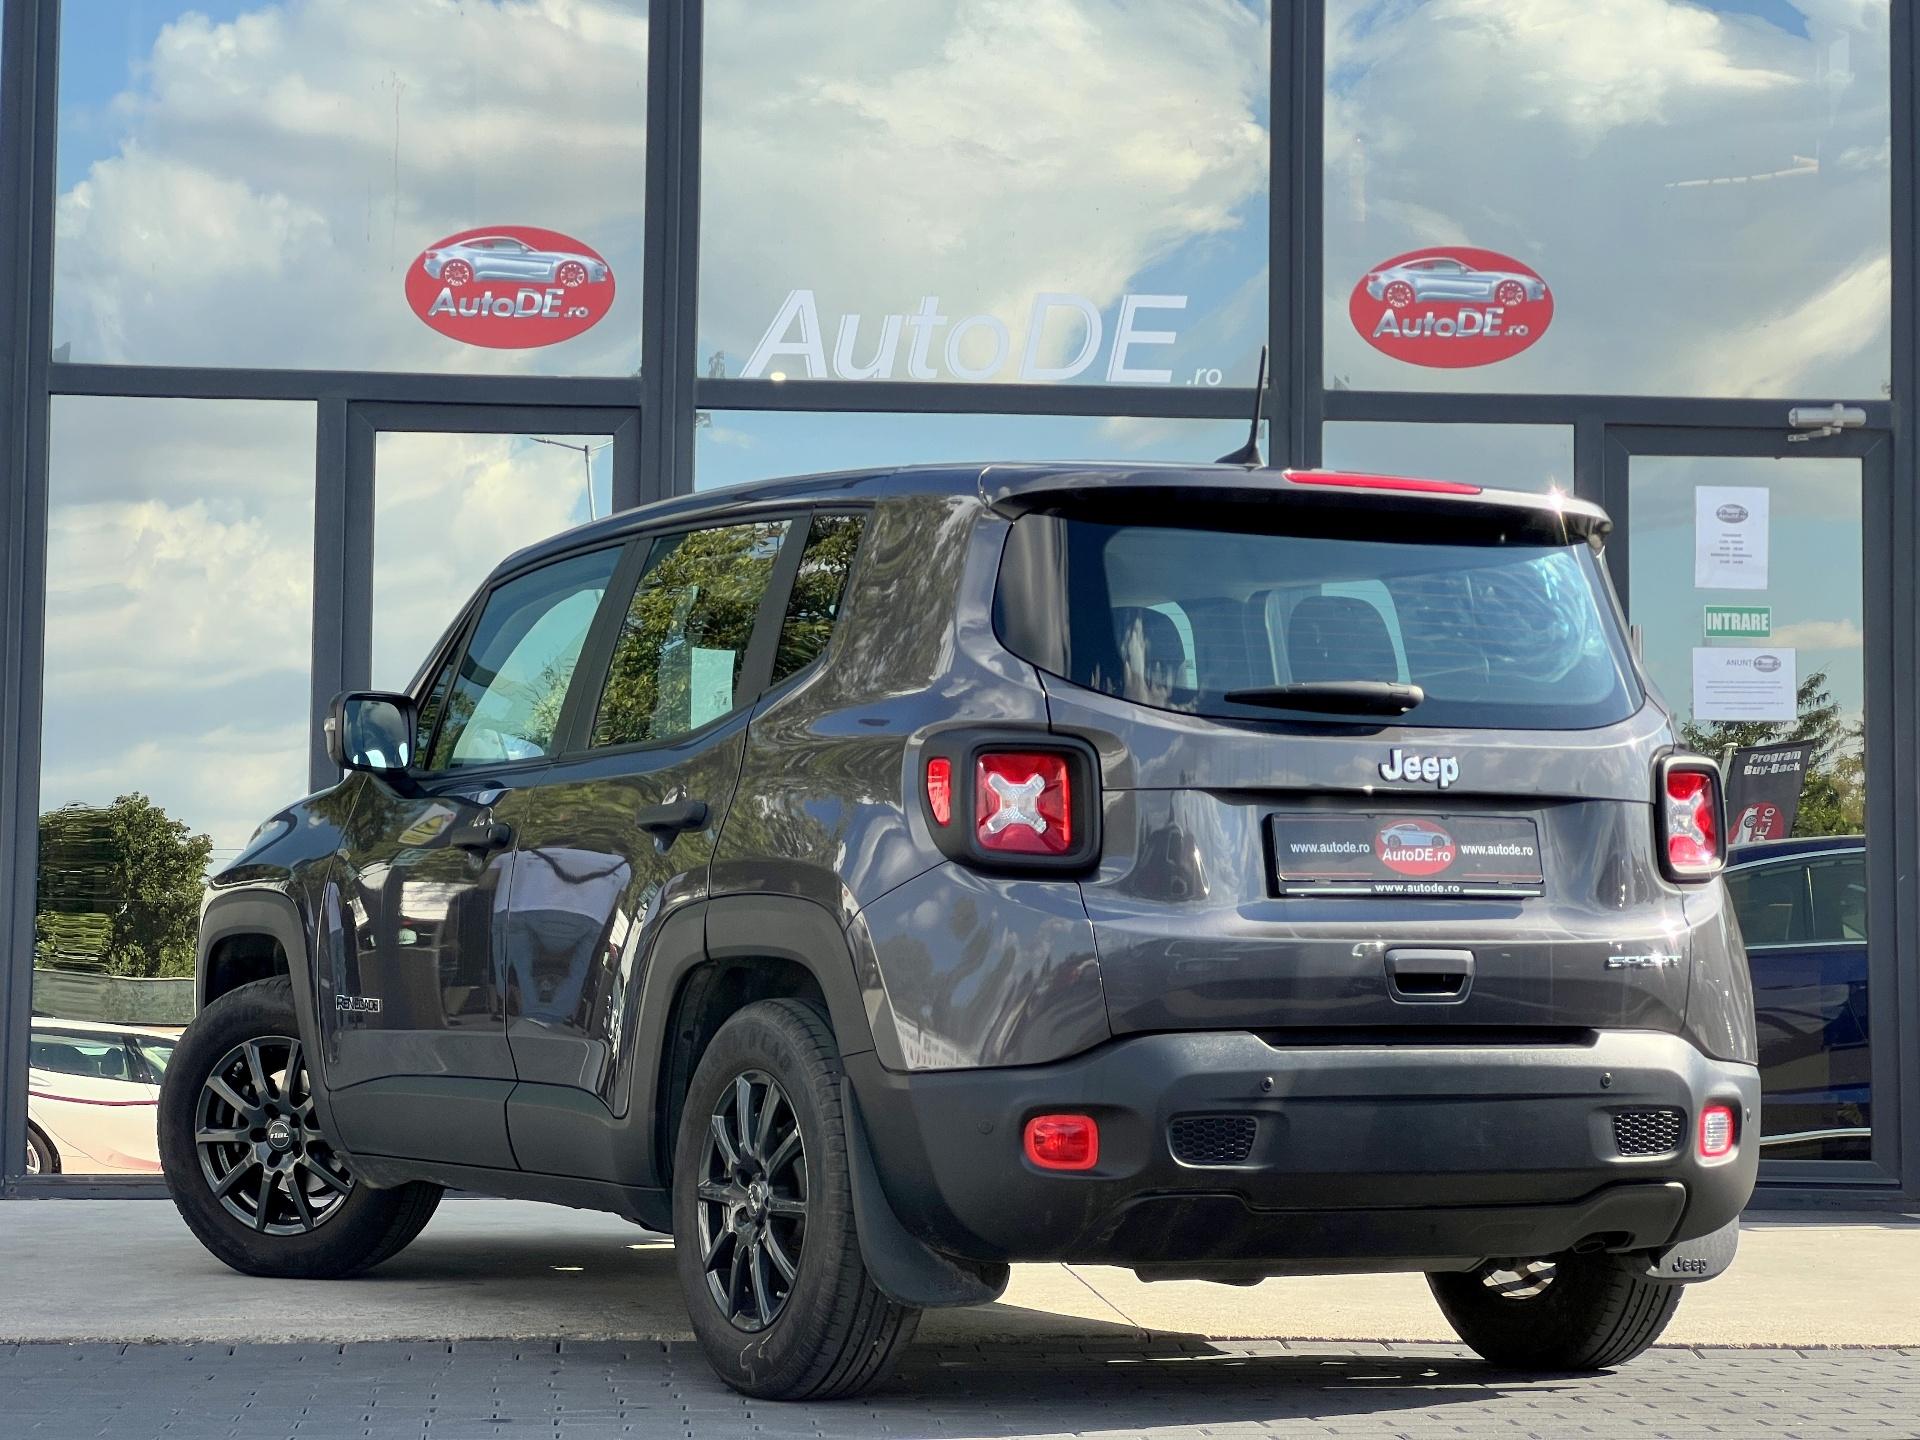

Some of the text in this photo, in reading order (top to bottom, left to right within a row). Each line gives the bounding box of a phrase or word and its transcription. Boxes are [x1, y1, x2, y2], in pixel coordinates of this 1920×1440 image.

[1706, 612, 1769, 632] INTRARE
[1749, 751, 1801, 763] Program
[1379, 748, 1460, 789] Jeep
[1744, 762, 1801, 775] Buy-Back
[1290, 841, 1371, 854] www.autode.ro
[1460, 842, 1535, 857] www.autode.ro
[1381, 848, 1452, 863] AutoDE.ro
[1374, 883, 1461, 894] www.autode.ro
[1672, 1256, 1706, 1274] Jeep
